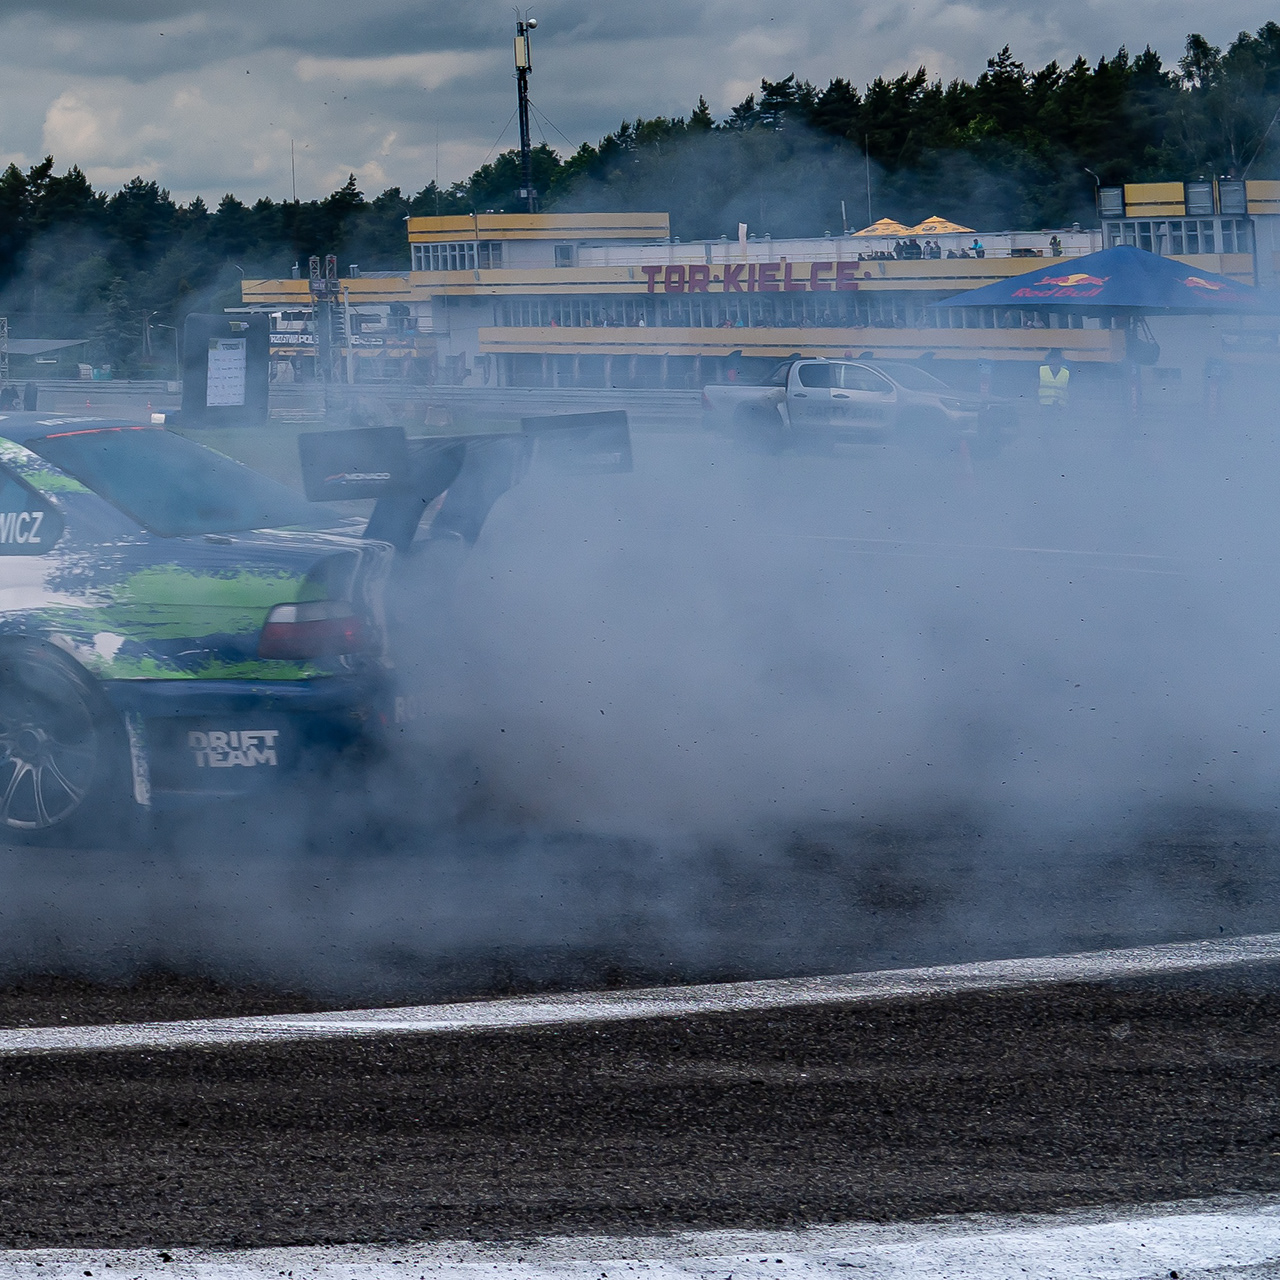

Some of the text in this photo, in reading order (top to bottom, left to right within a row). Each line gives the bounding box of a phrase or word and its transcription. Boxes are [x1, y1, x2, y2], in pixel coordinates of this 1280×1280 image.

[641, 261, 861, 293] TOR KIELCE
[1011, 287, 1105, 298] Red Bull
[188, 729, 280, 748] DRIFT
[194, 748, 278, 767] TEAM
